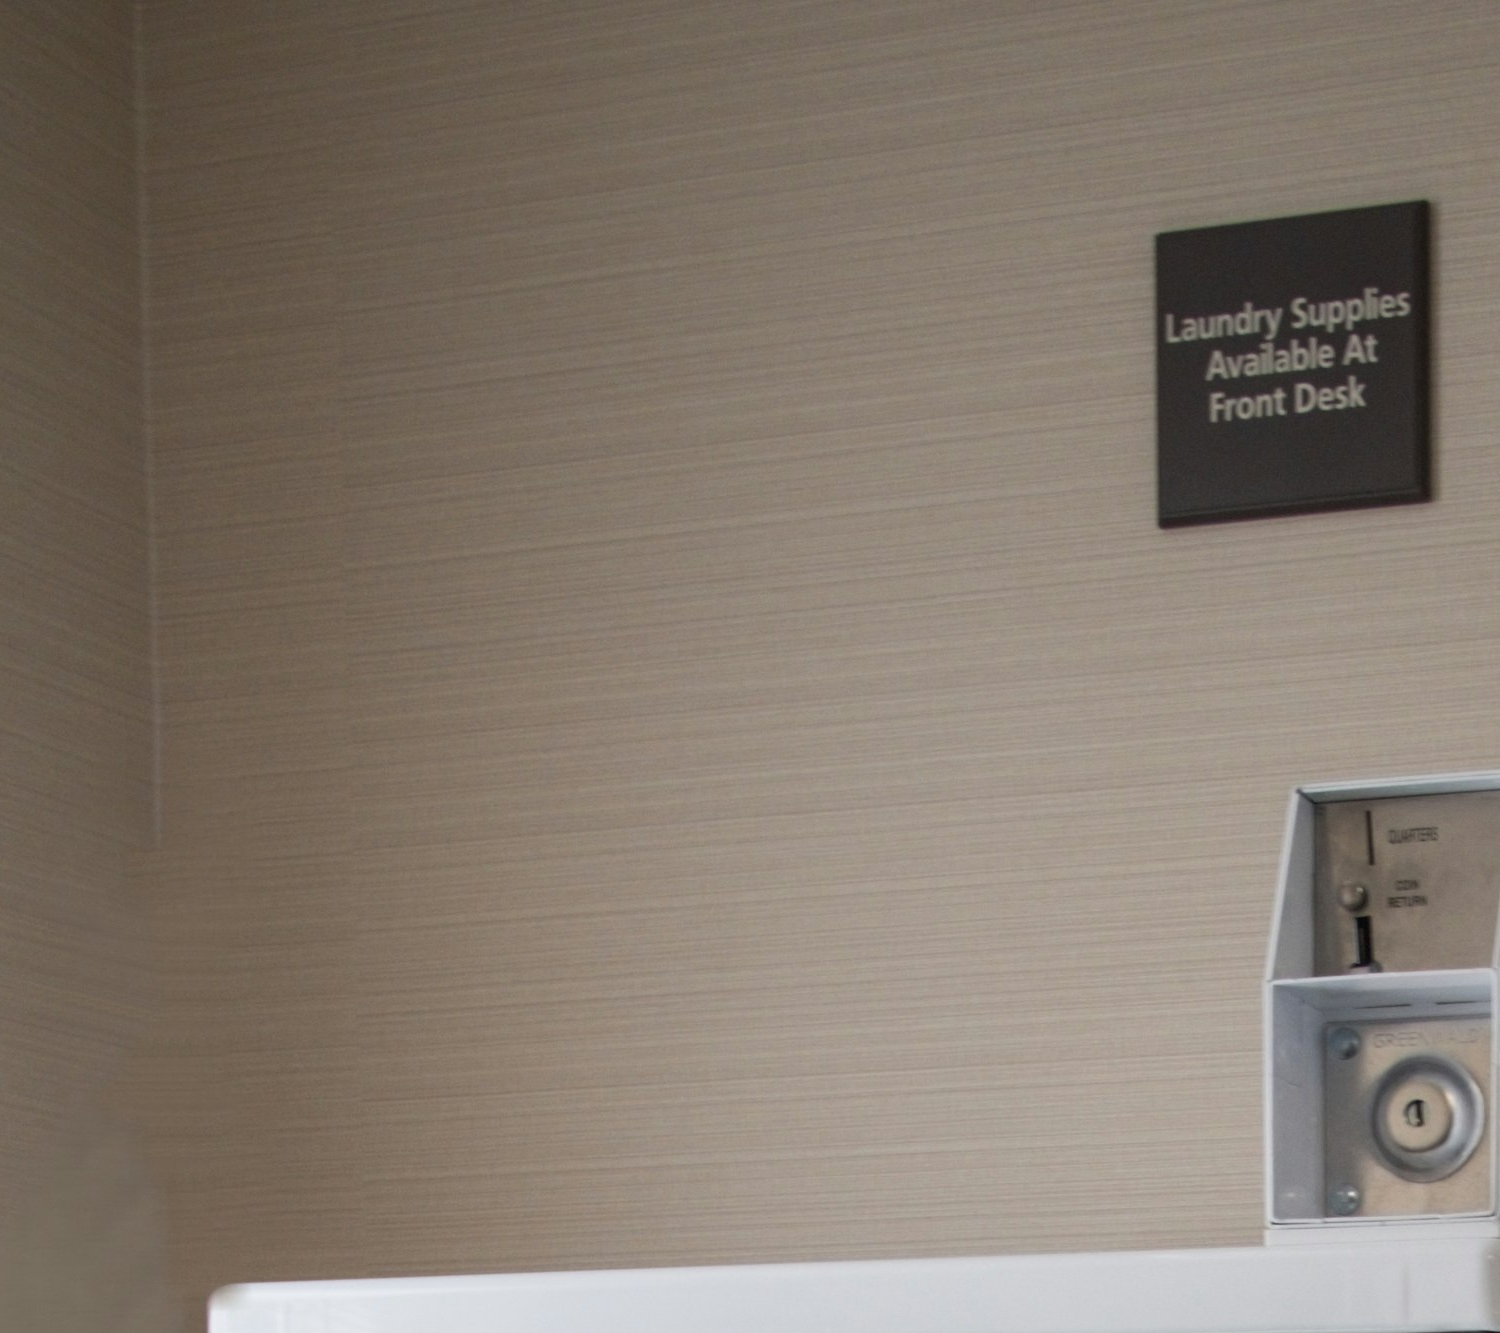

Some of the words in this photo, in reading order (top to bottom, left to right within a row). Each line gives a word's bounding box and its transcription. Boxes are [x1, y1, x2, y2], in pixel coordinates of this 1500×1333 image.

[1164, 303, 1283, 343] Laundry
[1290, 287, 1411, 333] Supplies
[1204, 337, 1335, 382] Available
[1342, 333, 1379, 366] At
[1209, 387, 1287, 423] Front
[1293, 376, 1367, 414] Desk
